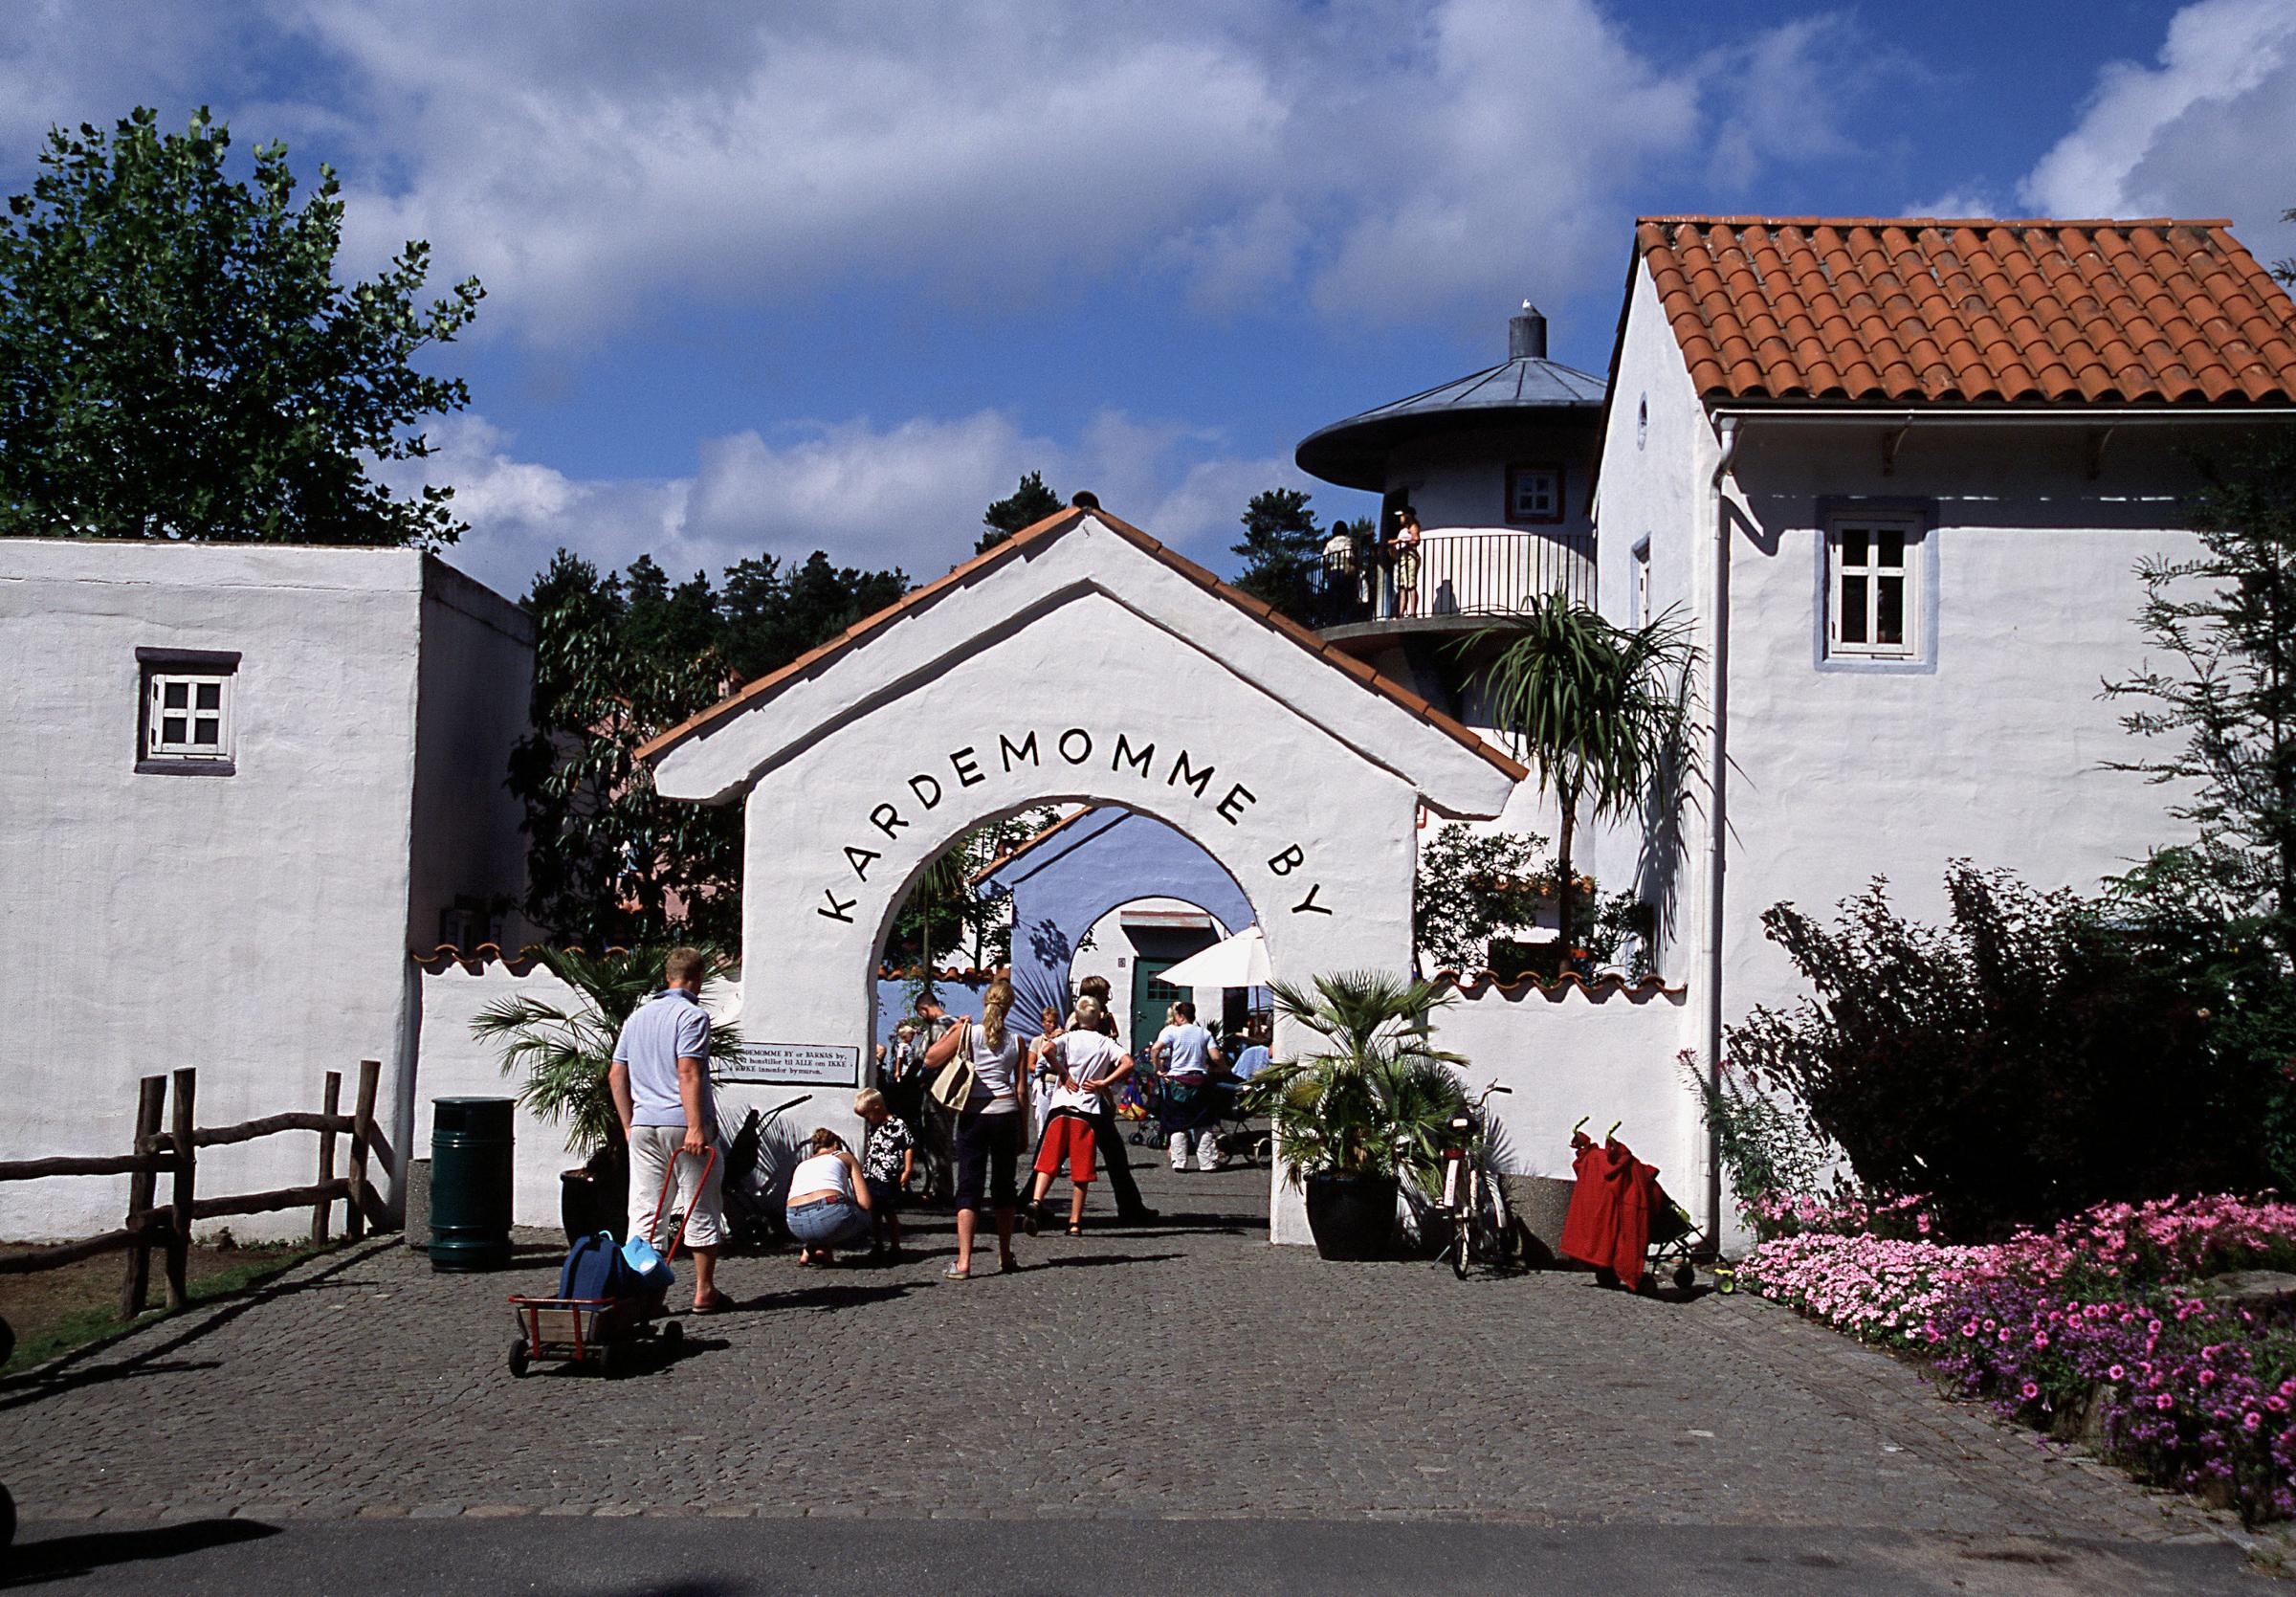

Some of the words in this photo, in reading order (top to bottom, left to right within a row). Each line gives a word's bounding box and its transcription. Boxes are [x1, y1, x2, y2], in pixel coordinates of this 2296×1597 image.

[817, 727, 1257, 923] KARDEMOMME
[1268, 843, 1333, 917] BY
[734, 1049, 782, 1057] DEMOMME
[806, 1051, 833, 1059] BARNAS
